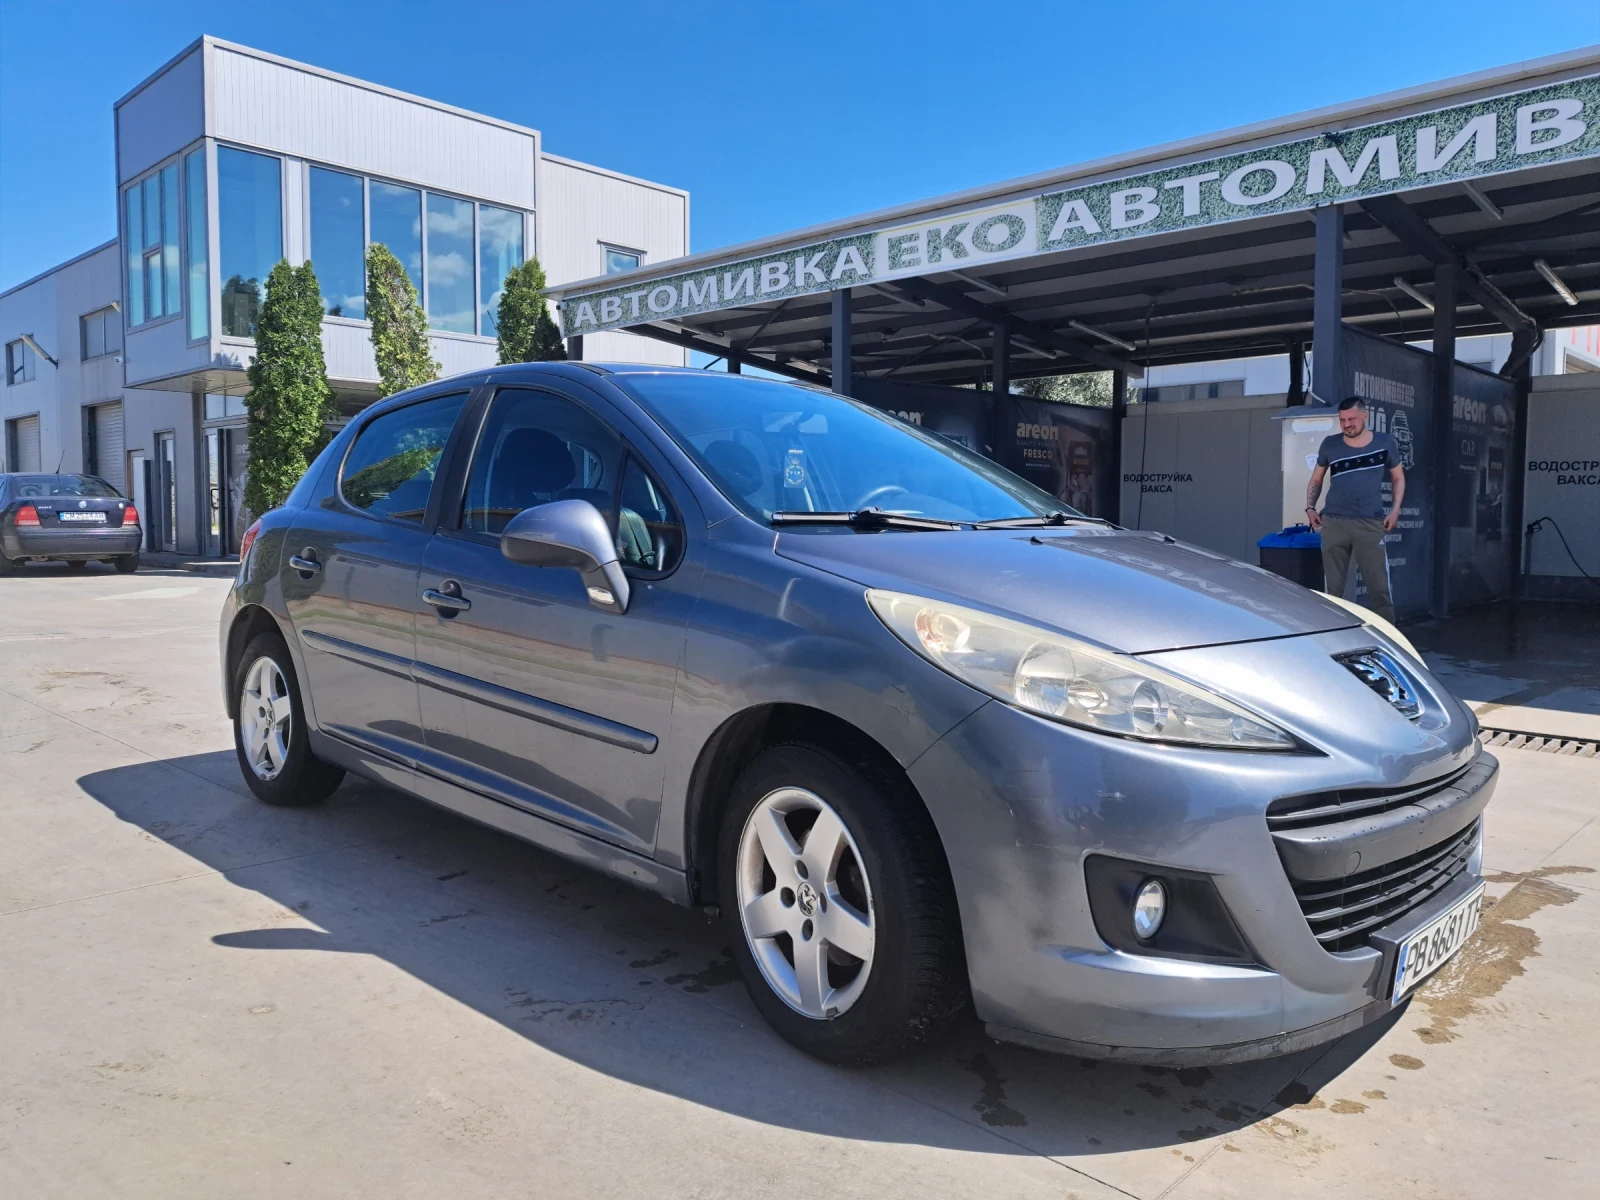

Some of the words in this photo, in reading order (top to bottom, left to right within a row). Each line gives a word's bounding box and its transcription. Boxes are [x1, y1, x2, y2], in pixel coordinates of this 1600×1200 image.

[573, 245, 869, 328] АВТОМИВКА
[887, 213, 1027, 271] ЕКО
[1048, 99, 1588, 242] АВТОМИВ
[1016, 422, 1059, 440] areon
[1023, 448, 1053, 459] FRESCO
[1528, 461, 1600, 473] ВОДОСТР
[1123, 472, 1193, 483] ВОДОСТРУЙКА
[1141, 485, 1173, 493] ВАКСА
[1402, 935, 1428, 987] PB
[1427, 907, 1465, 968] 8681
